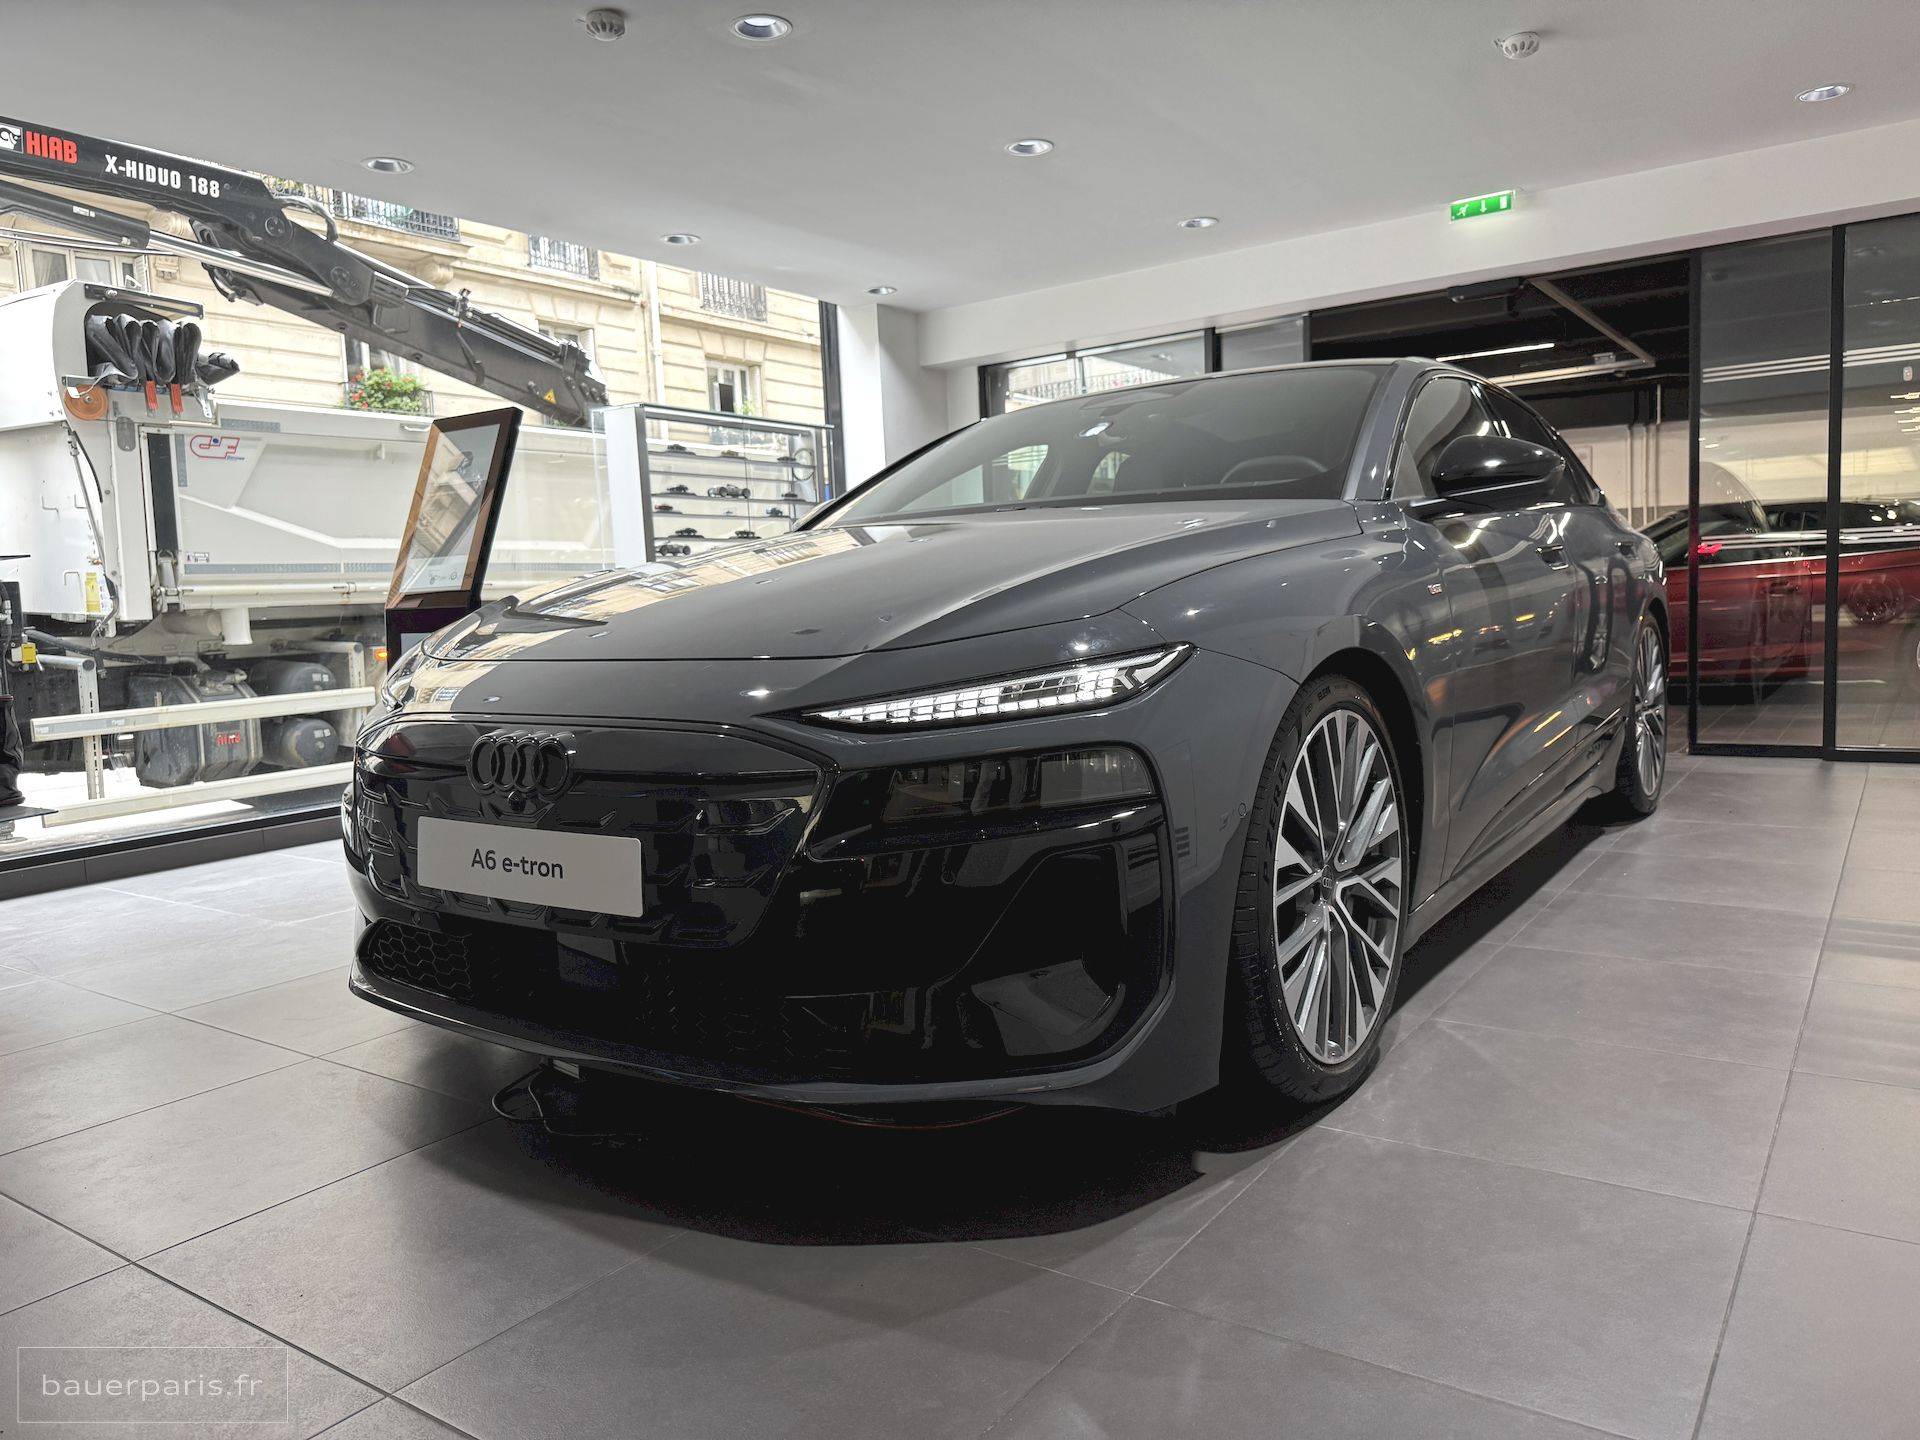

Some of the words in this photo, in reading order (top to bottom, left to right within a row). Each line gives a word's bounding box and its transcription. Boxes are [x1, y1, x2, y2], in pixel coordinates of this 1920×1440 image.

[26, 130, 78, 164] HIAB
[105, 154, 181, 189] X-HIDUO
[189, 175, 220, 198] 188
[471, 848, 497, 871] A6
[502, 856, 564, 879] e-tron
